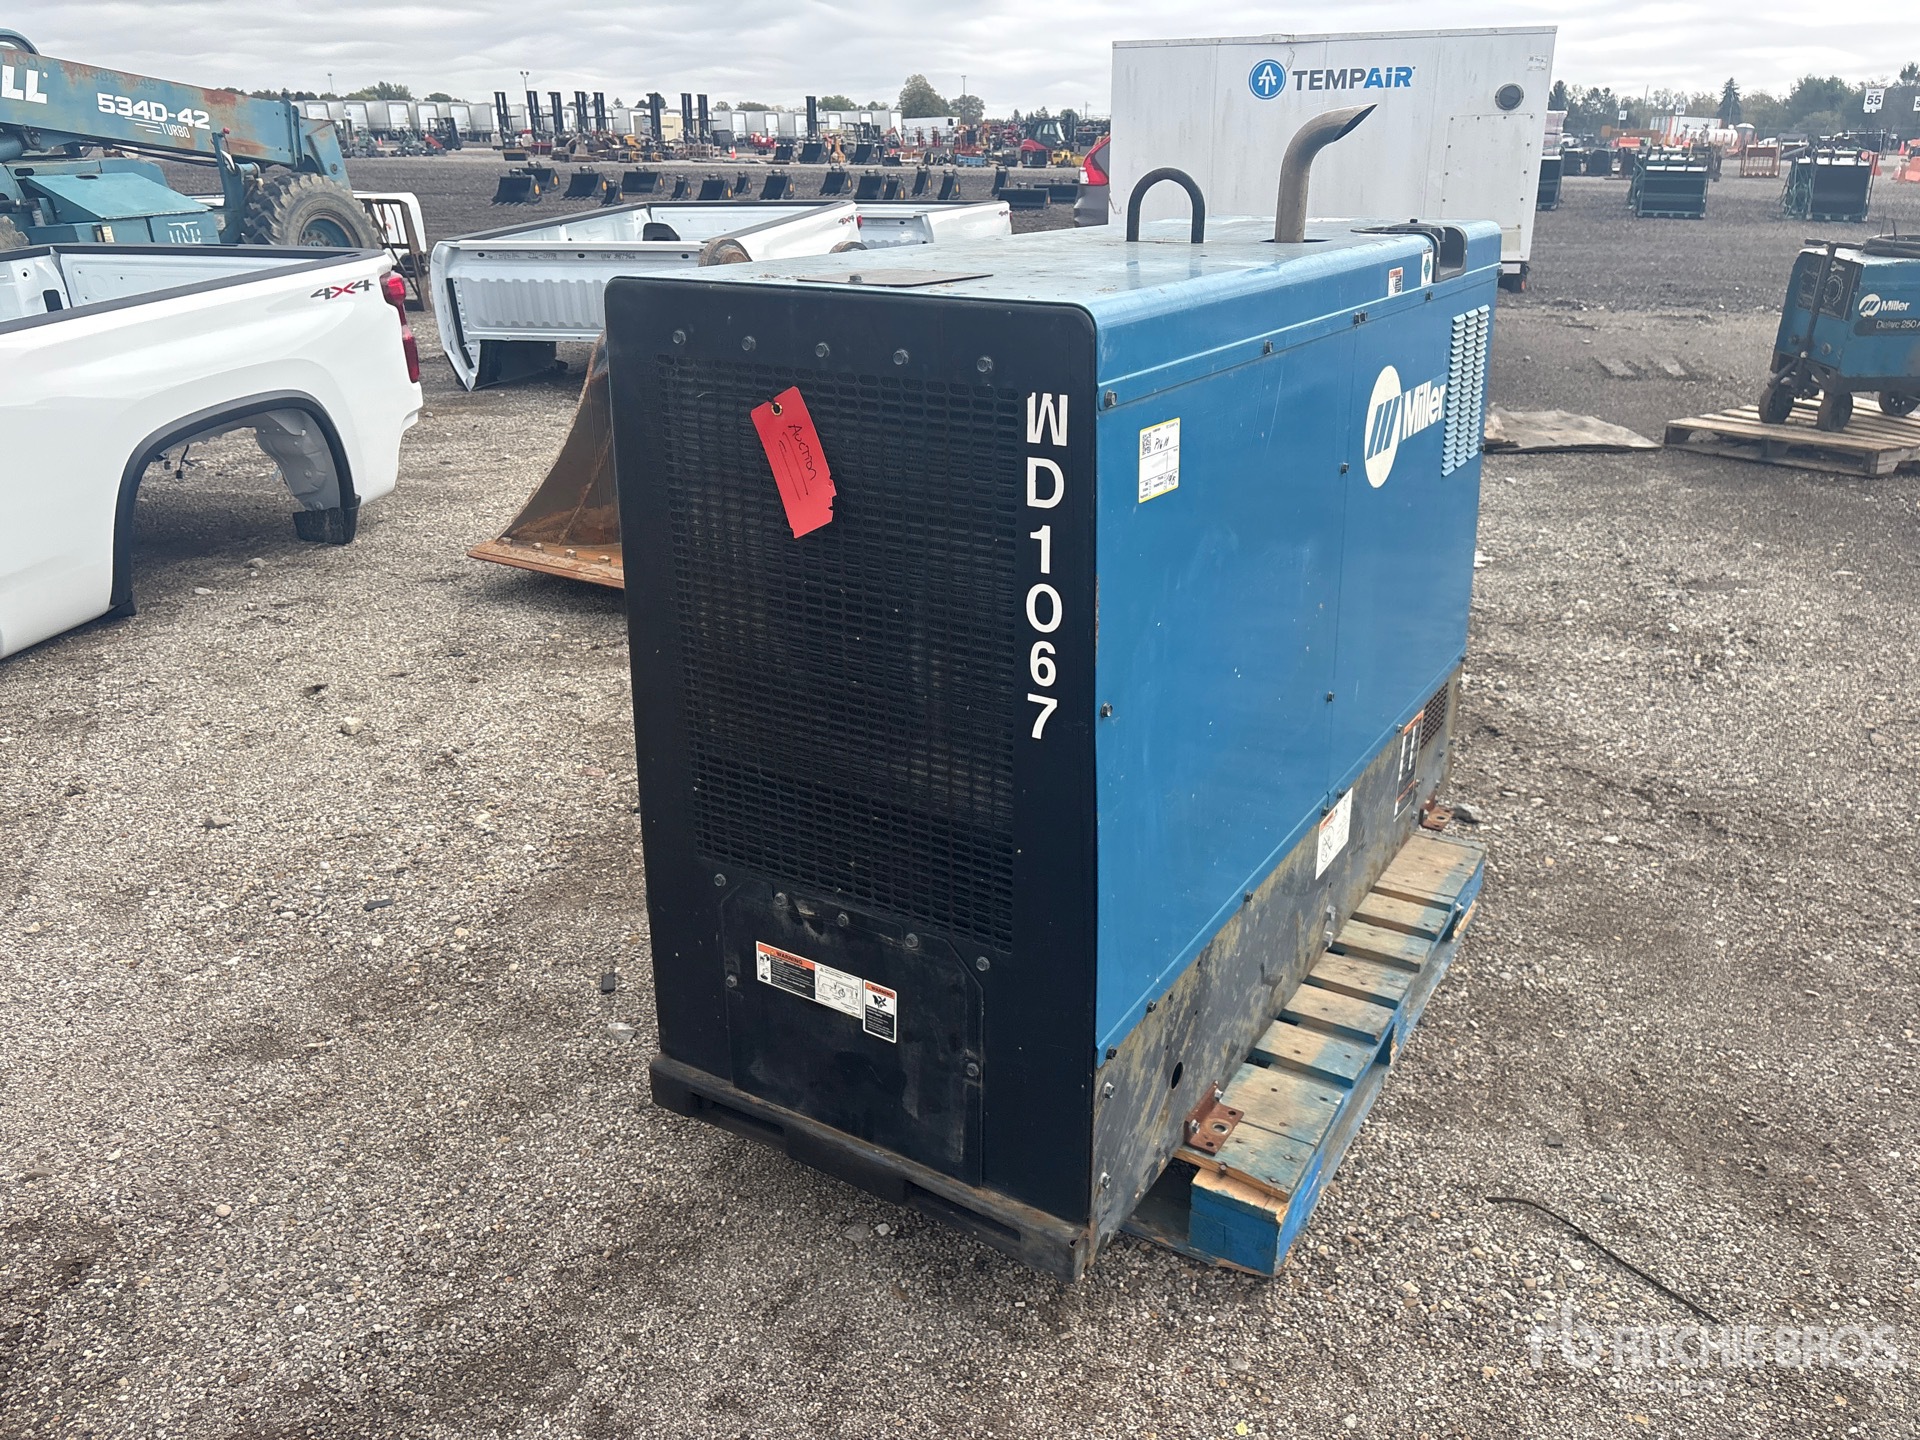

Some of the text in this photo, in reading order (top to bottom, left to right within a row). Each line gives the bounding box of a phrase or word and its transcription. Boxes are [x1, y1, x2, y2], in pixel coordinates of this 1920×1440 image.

[1866, 95, 1881, 105] 55
[96, 92, 210, 130] 534D-42
[161, 122, 191, 139] TURBO
[1881, 300, 1910, 311] Miller
[1901, 320, 1917, 329] 250
[1402, 381, 1447, 438] Miller
[776, 951, 803, 965] WARNING
[871, 986, 894, 998] WARNING
